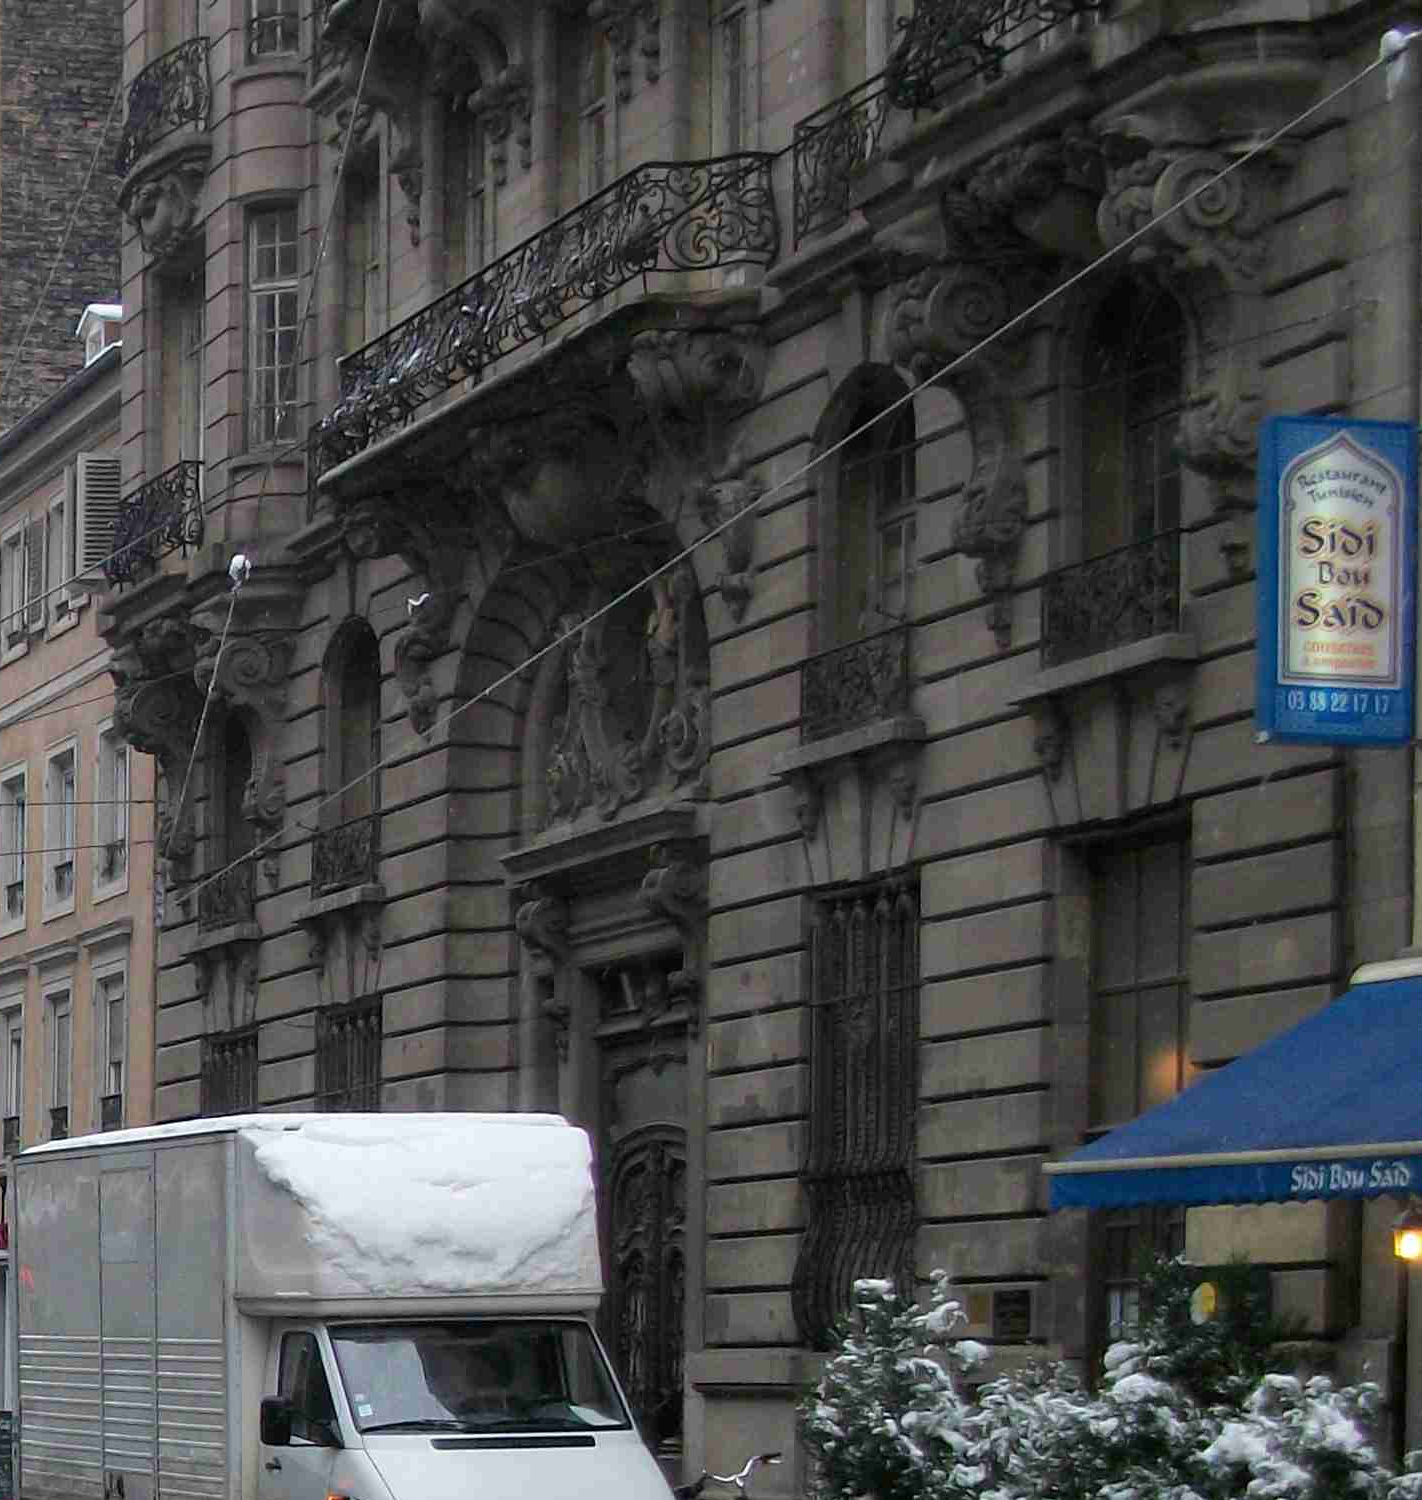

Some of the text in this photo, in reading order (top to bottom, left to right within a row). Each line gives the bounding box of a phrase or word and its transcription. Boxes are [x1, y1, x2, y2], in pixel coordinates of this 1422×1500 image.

[1301, 519, 1375, 556] Sidi
[1317, 560, 1371, 585] Bou
[1287, 690, 1306, 711] 03
[1330, 691, 1347, 713] 22
[1353, 693, 1369, 713] 17
[1374, 694, 1390, 715] 17
[1290, 1165, 1325, 1193] Sidi
[1329, 1163, 1364, 1190] Bou
